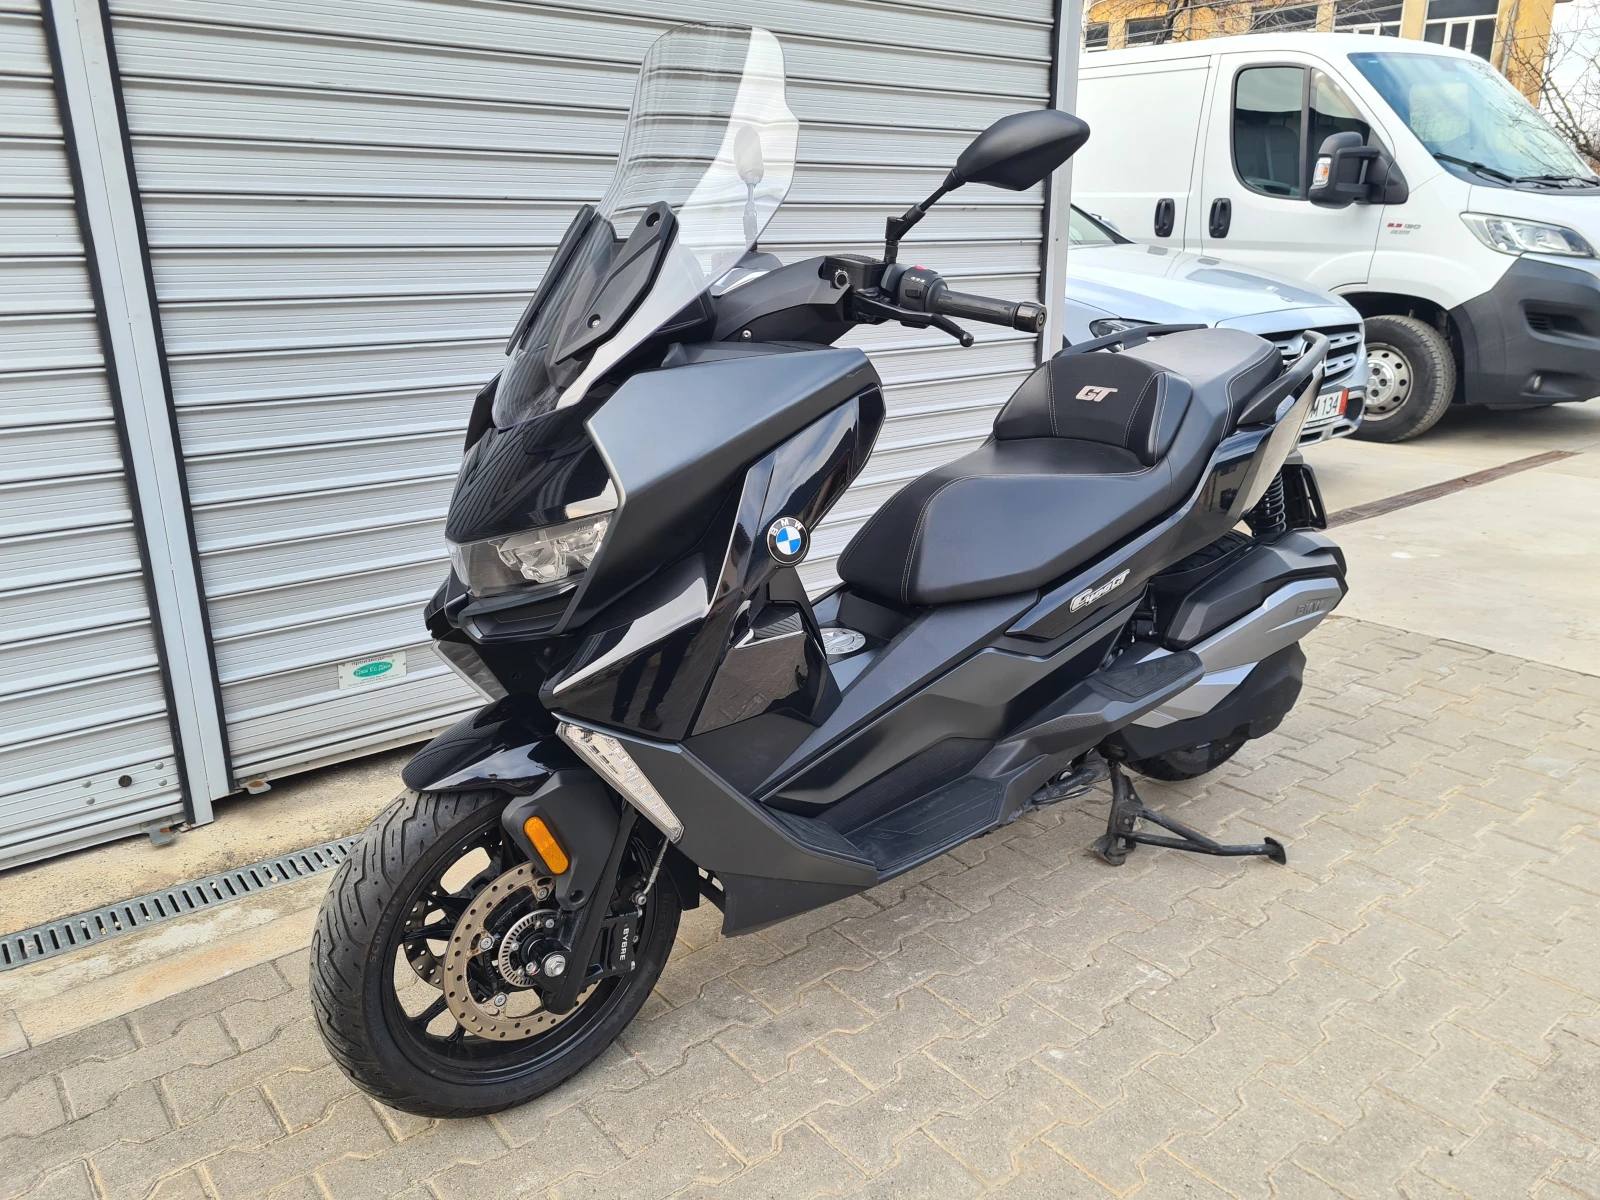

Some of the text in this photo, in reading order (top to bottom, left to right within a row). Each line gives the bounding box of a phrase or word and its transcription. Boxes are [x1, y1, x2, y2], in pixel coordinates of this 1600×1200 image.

[1075, 385, 1119, 403] GT
[1321, 394, 1340, 417] 134
[769, 517, 804, 537] BMW
[1295, 600, 1325, 616] BMW
[619, 927, 630, 961] BYBRE
